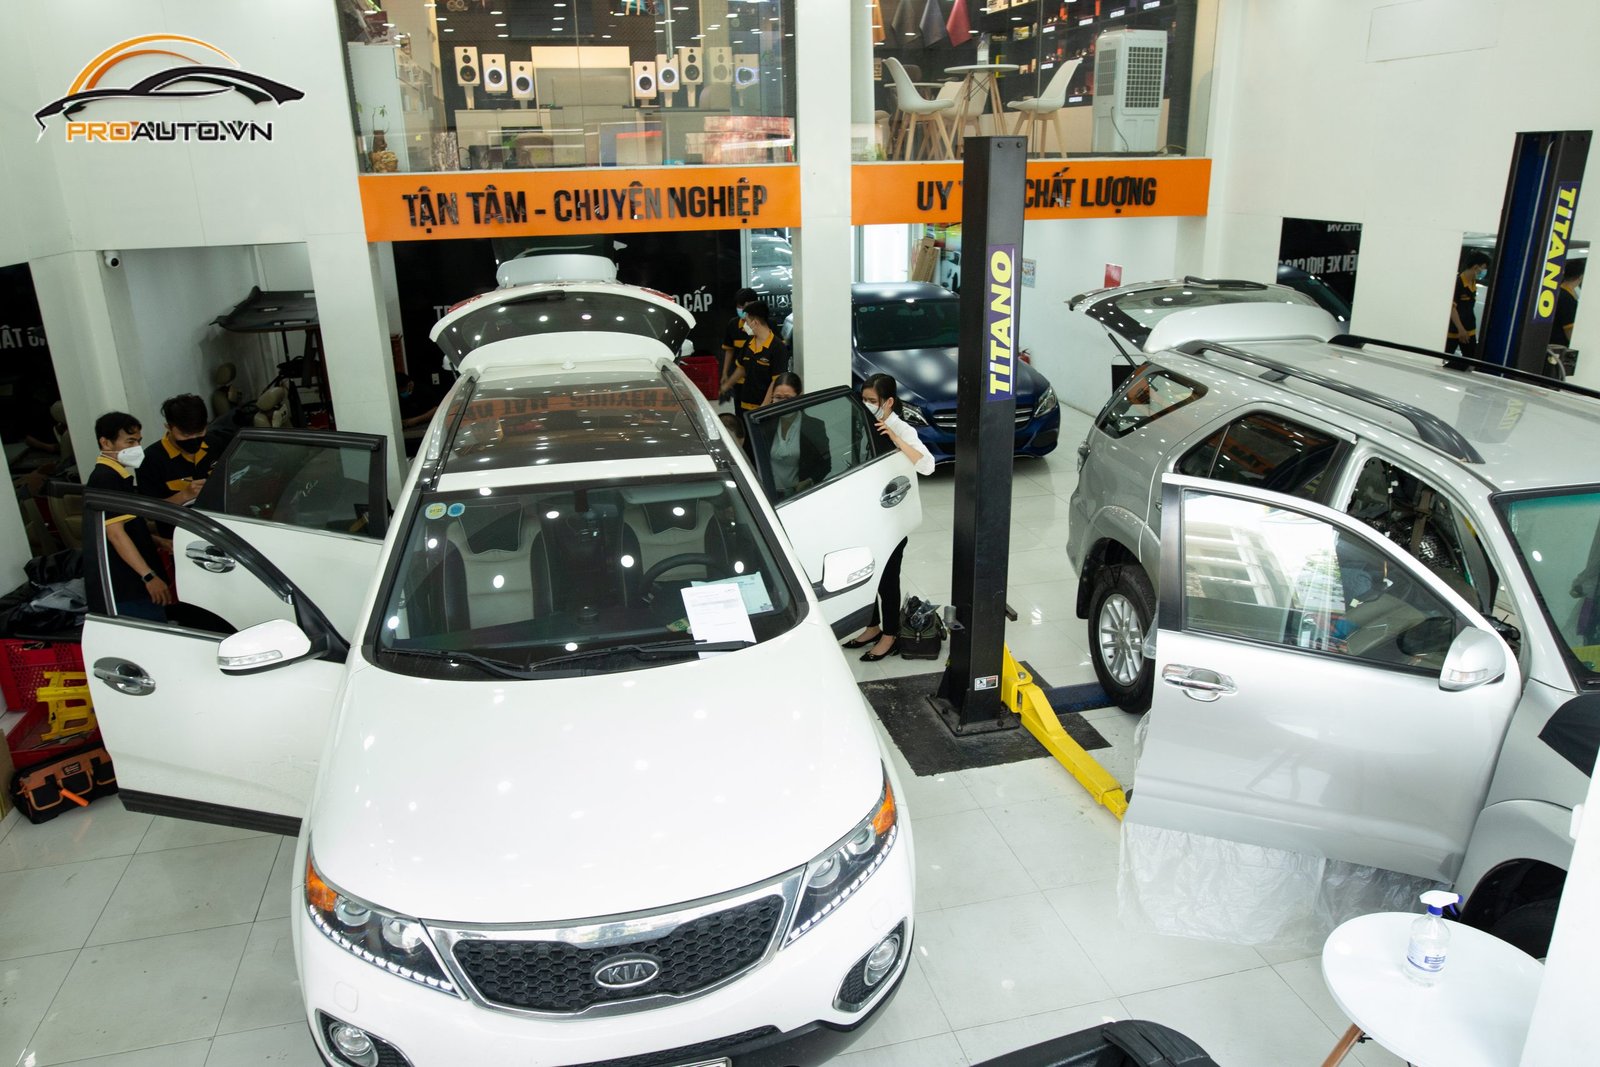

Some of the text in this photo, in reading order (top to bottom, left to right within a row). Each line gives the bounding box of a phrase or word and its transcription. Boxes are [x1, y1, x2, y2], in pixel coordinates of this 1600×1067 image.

[402, 186, 459, 234] TẬN
[466, 184, 527, 225] TÂM
[554, 181, 662, 222] CHUYÊN
[668, 176, 768, 224] NGHIỆP
[917, 180, 952, 211] UY
[1024, 166, 1157, 213] CHẤT LƯỢNG
[1538, 187, 1577, 318] TITANO
[684, 285, 713, 313] CẤP
[990, 250, 1012, 395] TITANO
[607, 964, 648, 983] KIA
